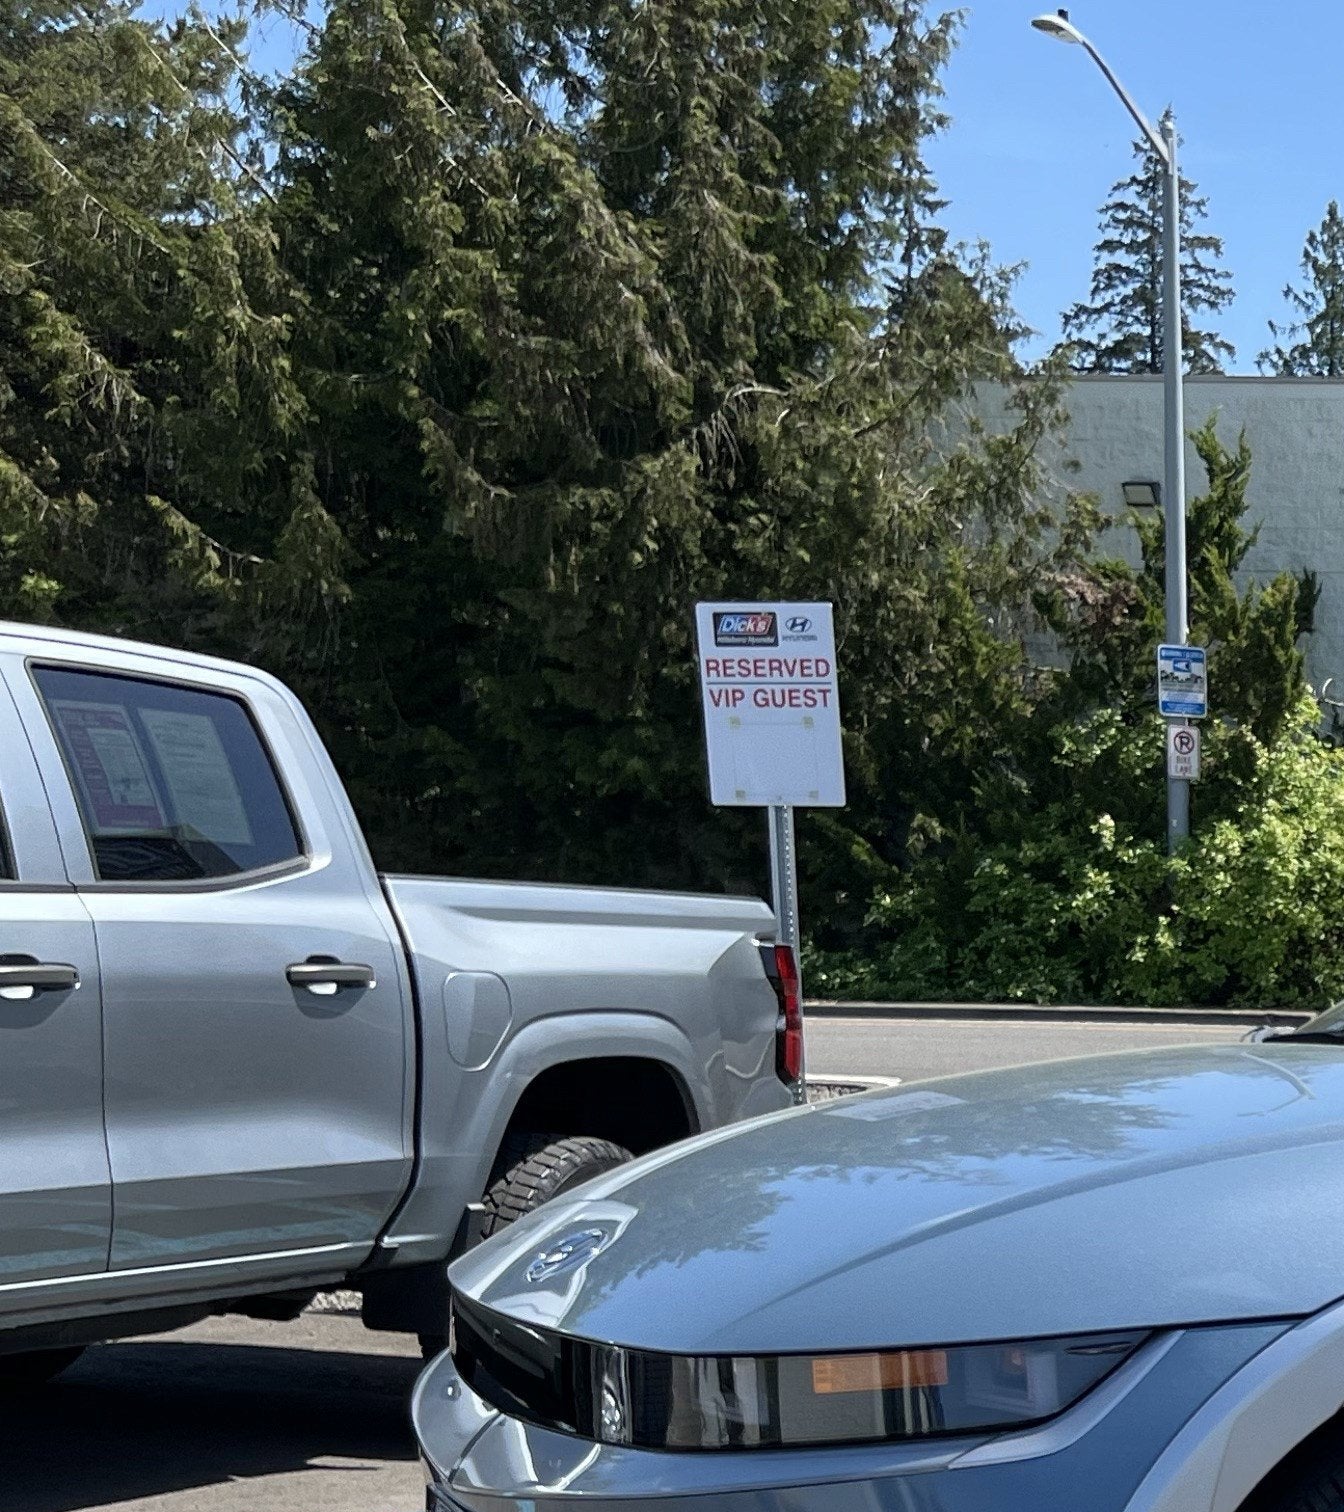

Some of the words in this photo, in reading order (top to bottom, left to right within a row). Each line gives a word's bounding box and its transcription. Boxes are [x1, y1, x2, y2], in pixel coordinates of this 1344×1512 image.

[705, 658, 831, 678] RESERVED
[709, 688, 745, 708] VIP
[753, 688, 832, 708] GUEST
